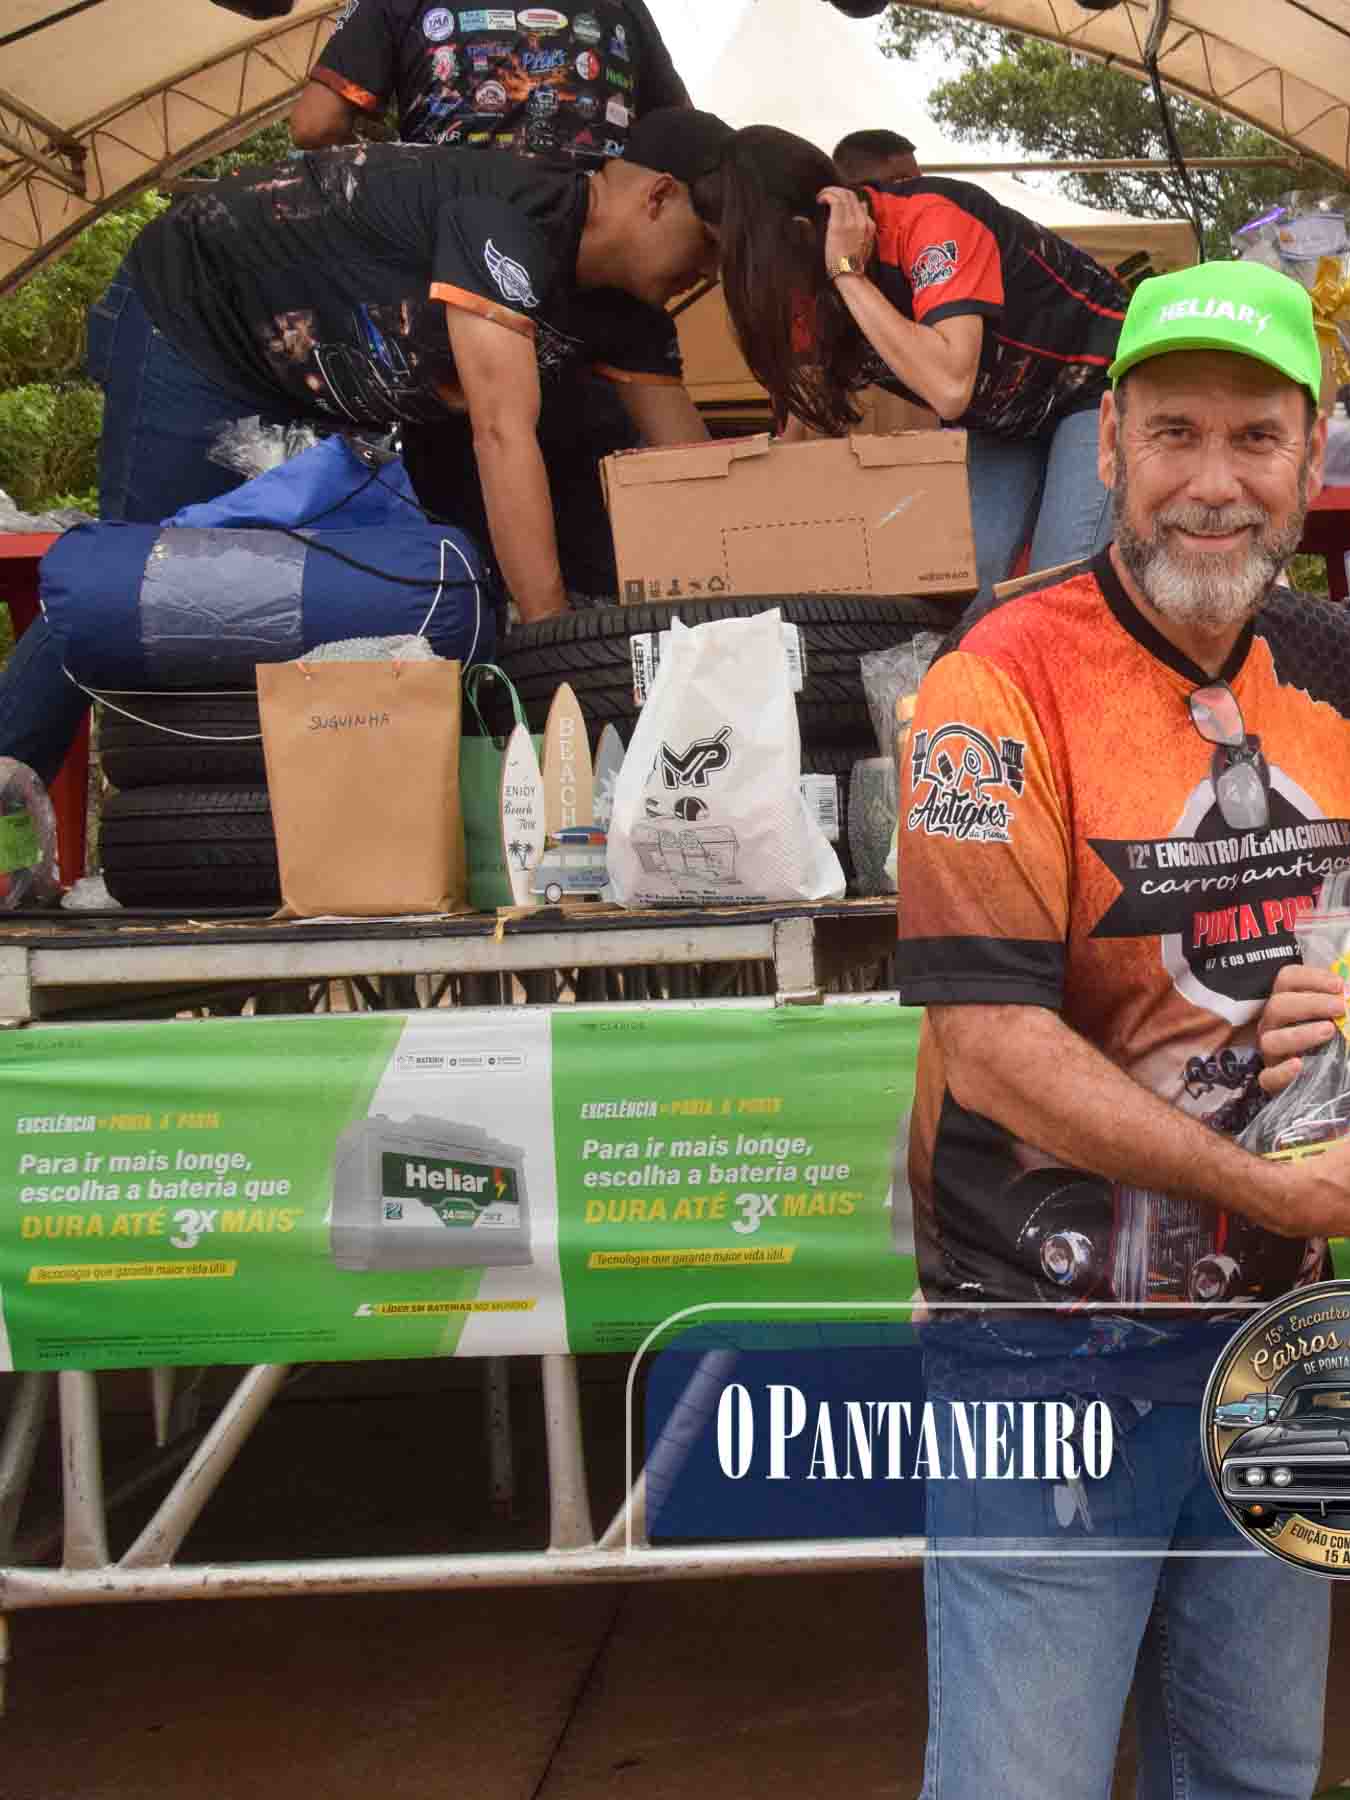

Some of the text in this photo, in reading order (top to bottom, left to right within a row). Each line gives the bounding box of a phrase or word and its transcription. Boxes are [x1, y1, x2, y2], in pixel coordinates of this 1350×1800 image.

[559, 717, 577, 828] BEACH
[505, 785, 536, 797] ENJOY
[1155, 838, 1240, 868] ENCONTRO
[19, 1149, 252, 1175] Para ir mais longe,
[582, 1134, 813, 1161] Para ir mais longe,
[405, 1162, 489, 1193] Heliar
[584, 1160, 850, 1187] escolha a bateria que
[20, 1174, 290, 1203] escolha a bateria que
[20, 1214, 104, 1239] DURA
[109, 1204, 167, 1236] ATÉ
[585, 1198, 665, 1224] DURA
[673, 1191, 728, 1220] ATÉ
